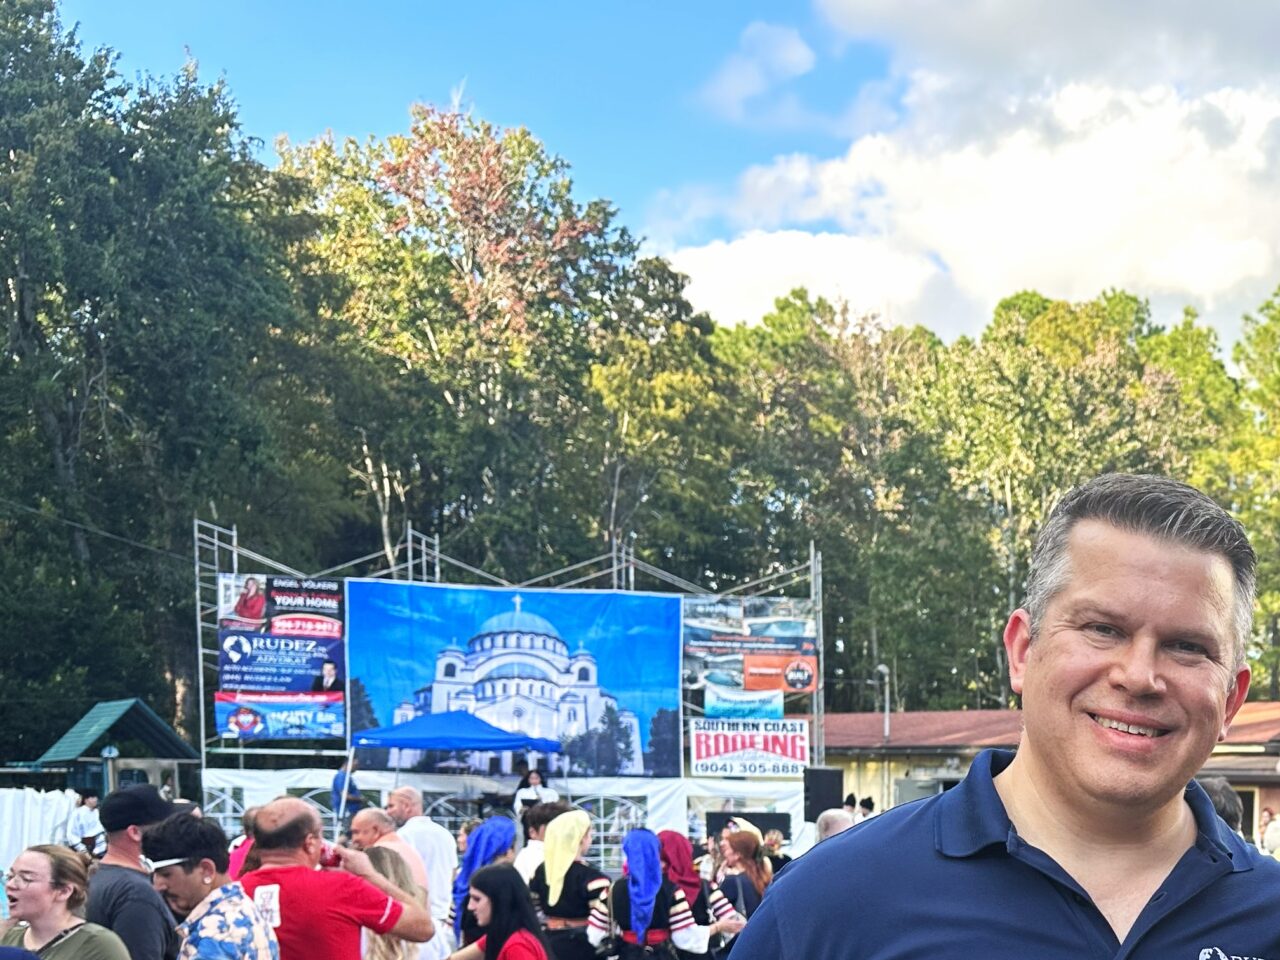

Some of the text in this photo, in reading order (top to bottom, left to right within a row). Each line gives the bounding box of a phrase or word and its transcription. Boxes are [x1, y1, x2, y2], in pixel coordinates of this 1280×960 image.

[275, 596, 338, 609] YOUR HOME
[252, 637, 317, 651] RUDEZ
[695, 719, 805, 733] SOUTHERN COAST
[695, 732, 806, 762] ROOFING
[695, 762, 734, 774] (904)
